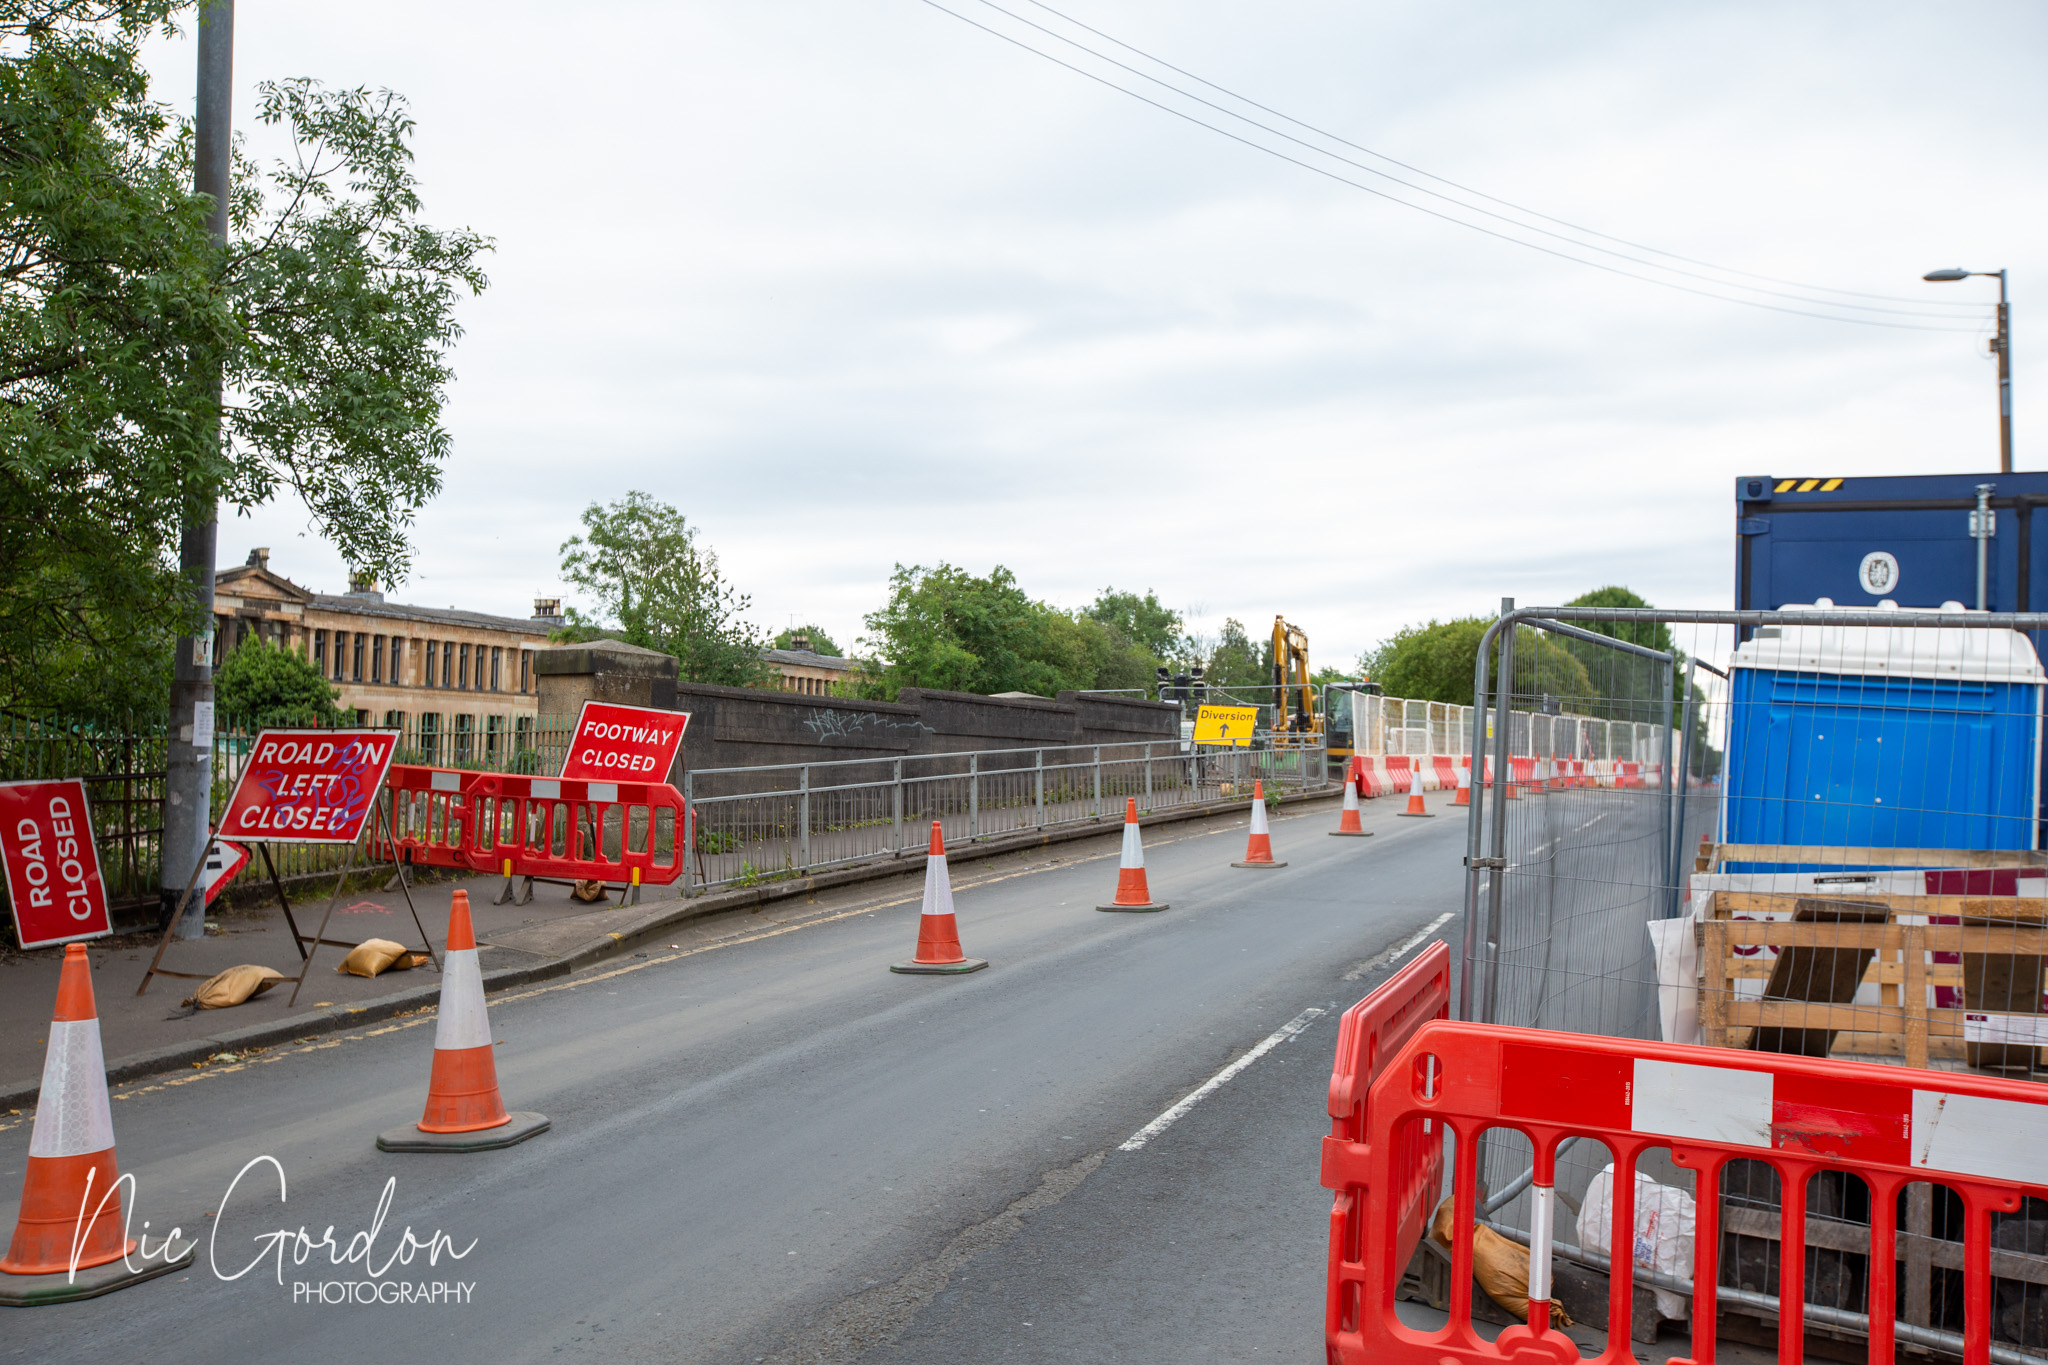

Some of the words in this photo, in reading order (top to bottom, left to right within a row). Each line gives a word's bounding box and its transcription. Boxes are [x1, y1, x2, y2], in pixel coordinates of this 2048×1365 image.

[1200, 709, 1254, 721] Diversion
[583, 720, 673, 746] FOOTWAY
[258, 741, 334, 765] ROAD
[343, 741, 386, 765] ON
[582, 748, 656, 772] CLOSED
[276, 774, 342, 796] LEFT
[240, 804, 350, 831] CLOSED
[21, 818, 53, 908] ROAD
[49, 797, 92, 921] CLOSED
